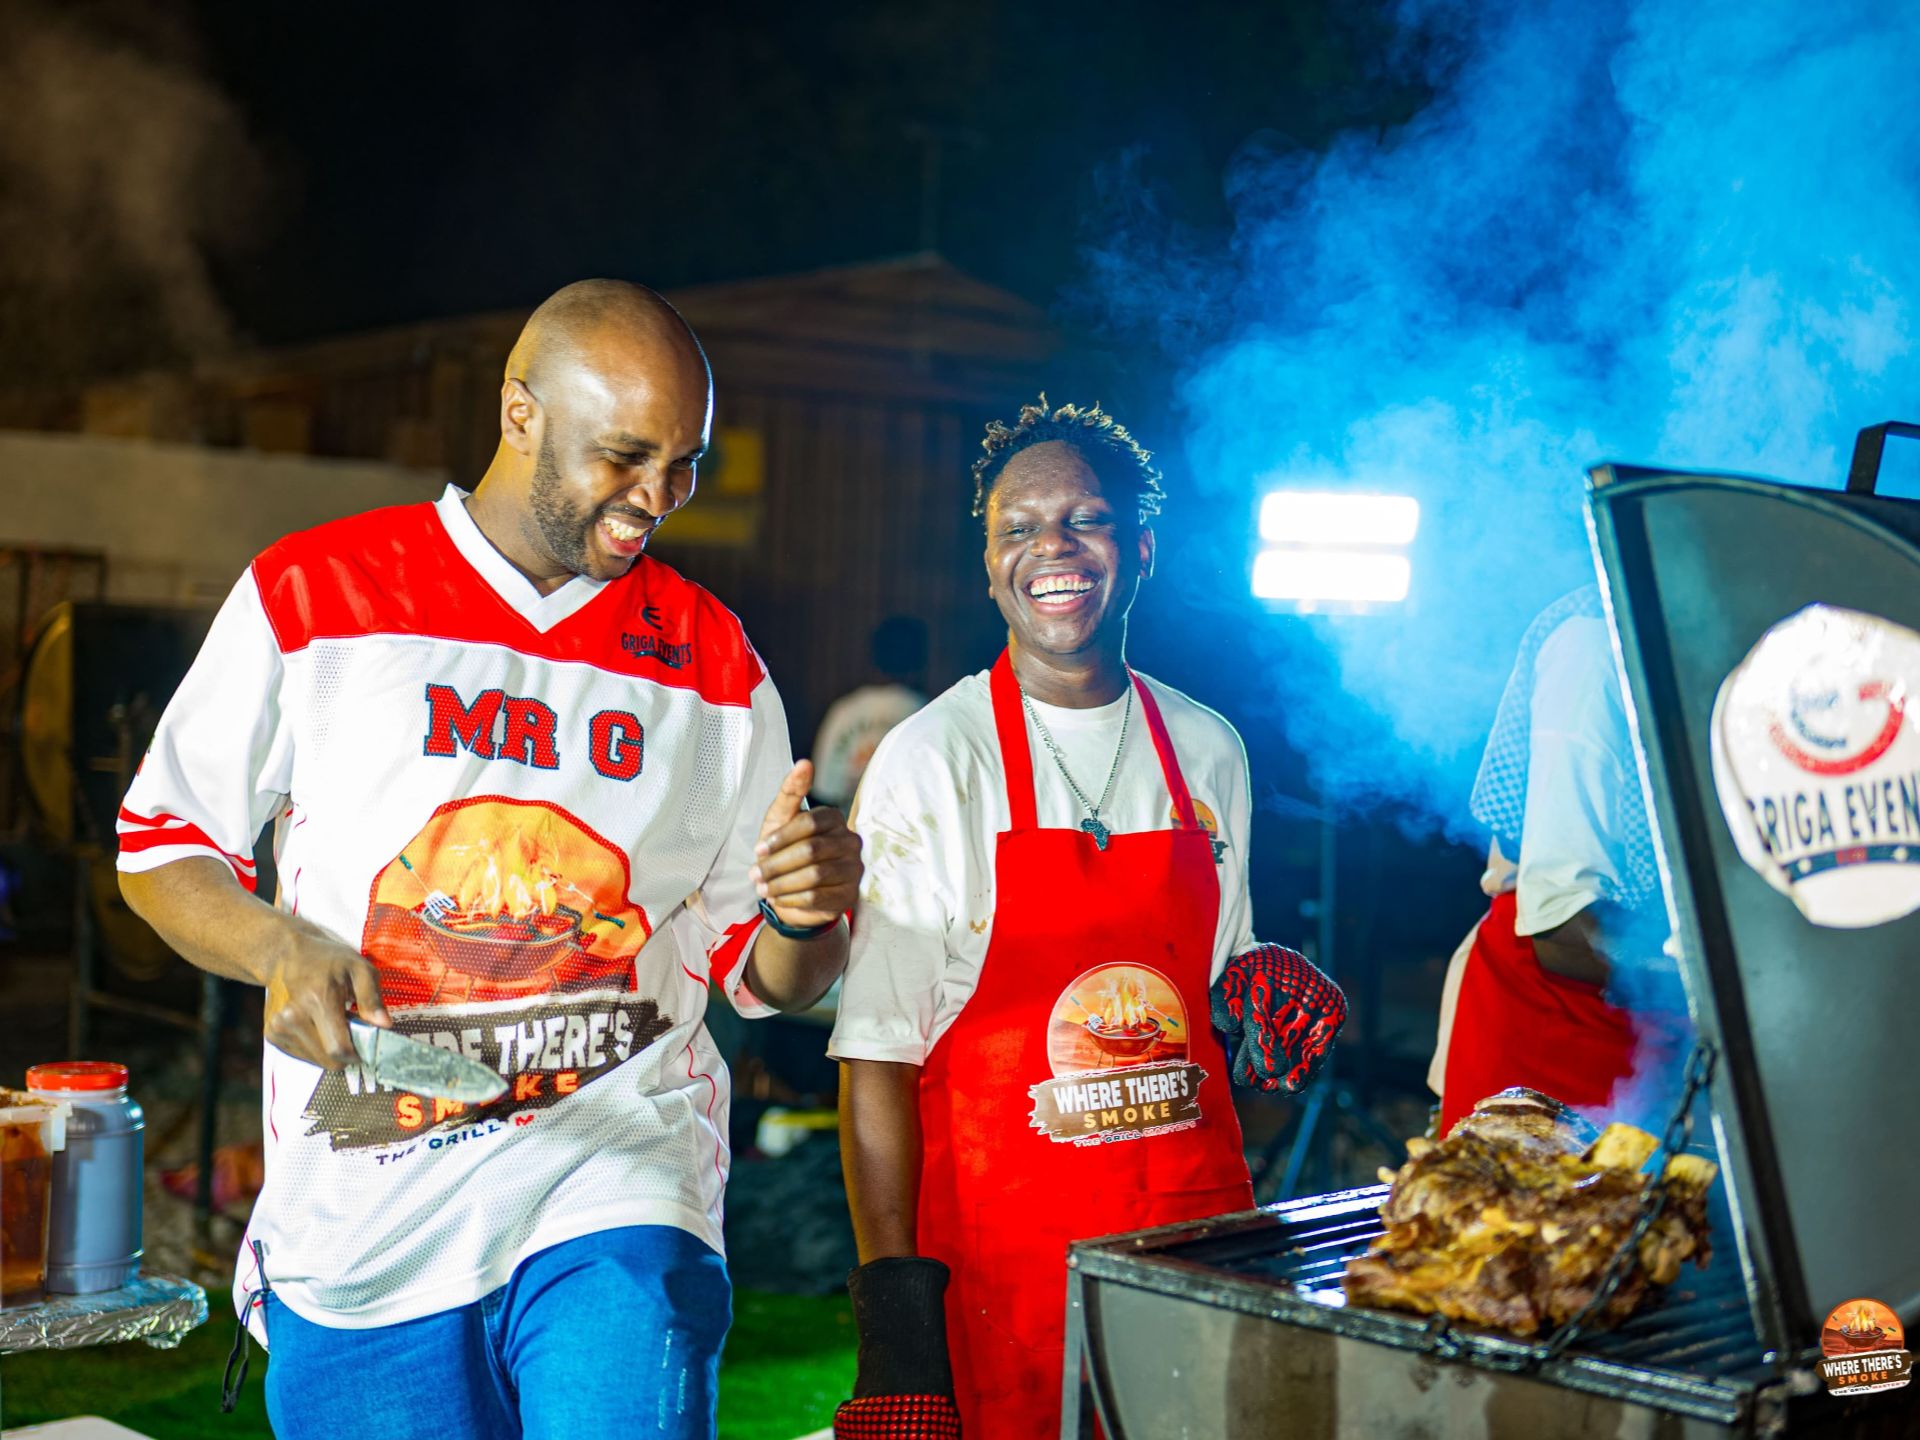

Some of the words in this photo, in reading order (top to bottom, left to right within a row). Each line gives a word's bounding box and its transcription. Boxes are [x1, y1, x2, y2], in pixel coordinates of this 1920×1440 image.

[621, 632, 656, 651] GRIGA
[657, 637, 692, 664] EVENTS
[423, 683, 560, 770] MR
[589, 710, 644, 782] G
[494, 1009, 633, 1075] THERE'S
[396, 1073, 579, 1130] SMKE
[1052, 1080, 1124, 1115] WHERE
[1125, 1069, 1189, 1108] THERE'S
[1074, 1138, 1101, 1148] THE
[1143, 1121, 1197, 1137] MASTER'S
[1084, 1102, 1171, 1129] SMOKE
[376, 1144, 417, 1165] THE
